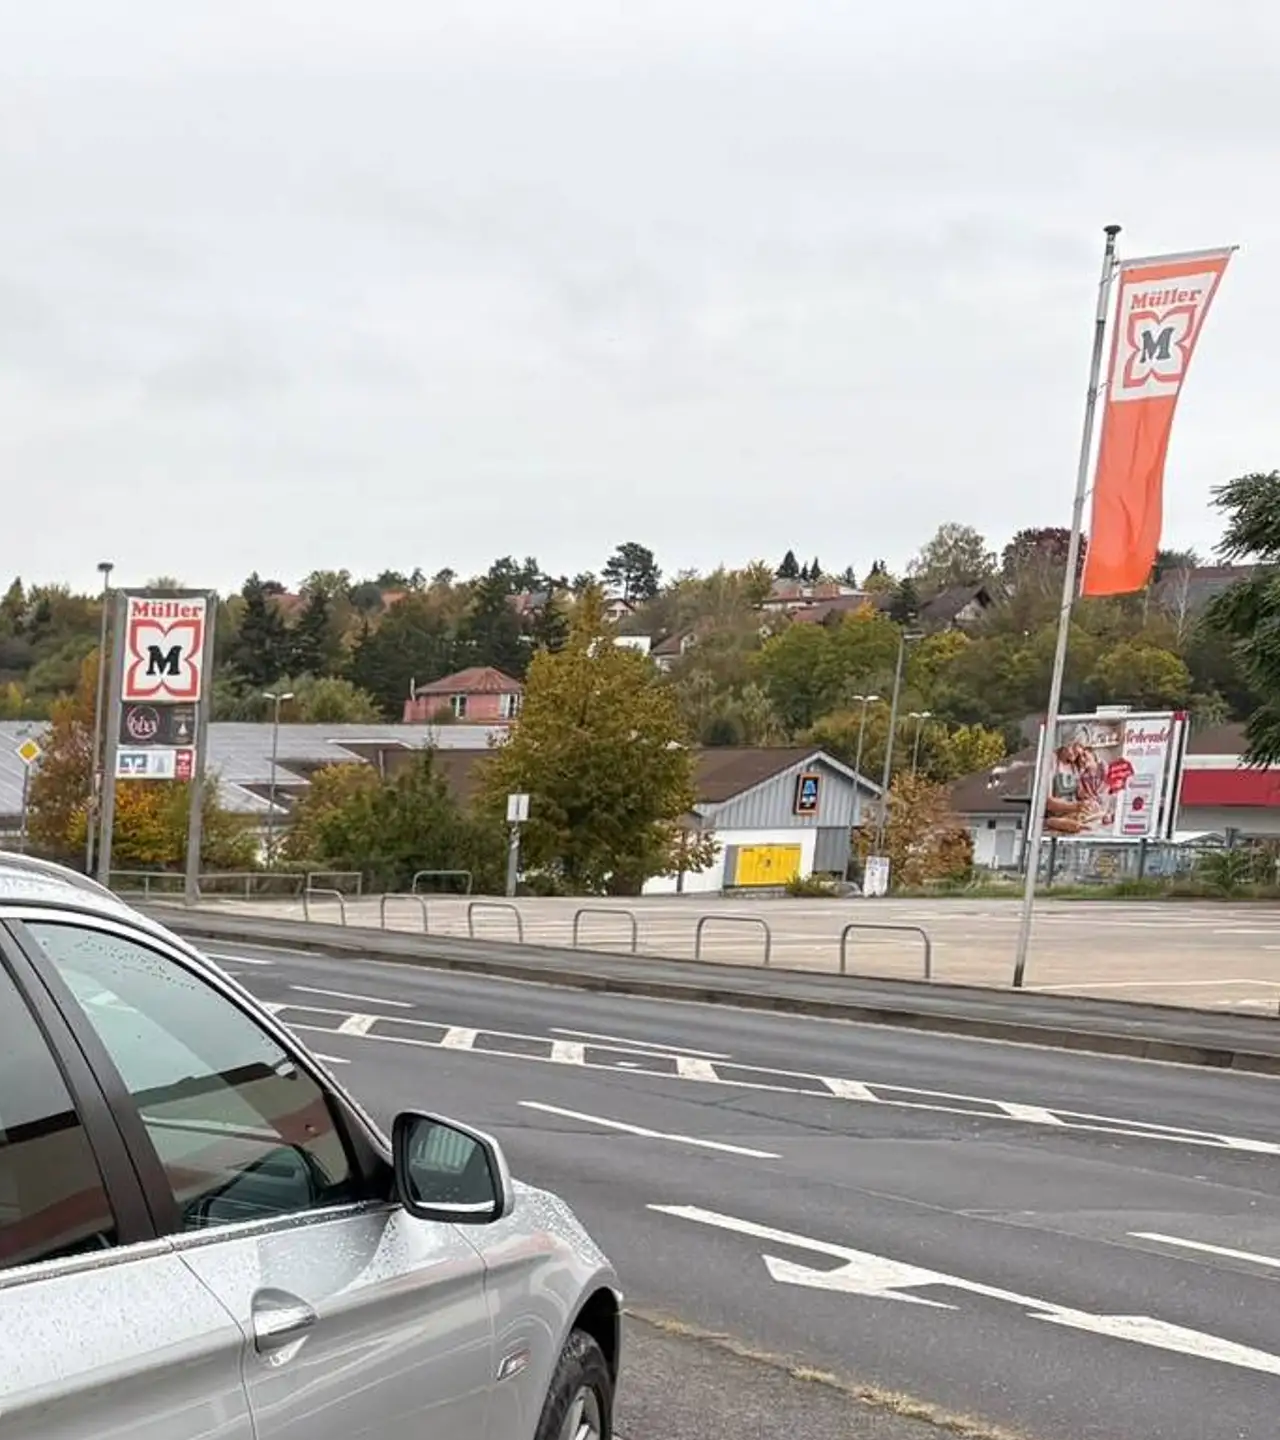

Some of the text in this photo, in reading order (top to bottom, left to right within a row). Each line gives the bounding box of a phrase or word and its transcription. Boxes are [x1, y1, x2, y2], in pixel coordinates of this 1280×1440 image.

[1131, 287, 1202, 309] Müller
[1140, 327, 1175, 363] M
[132, 602, 203, 618] Müller
[146, 645, 182, 675] M
